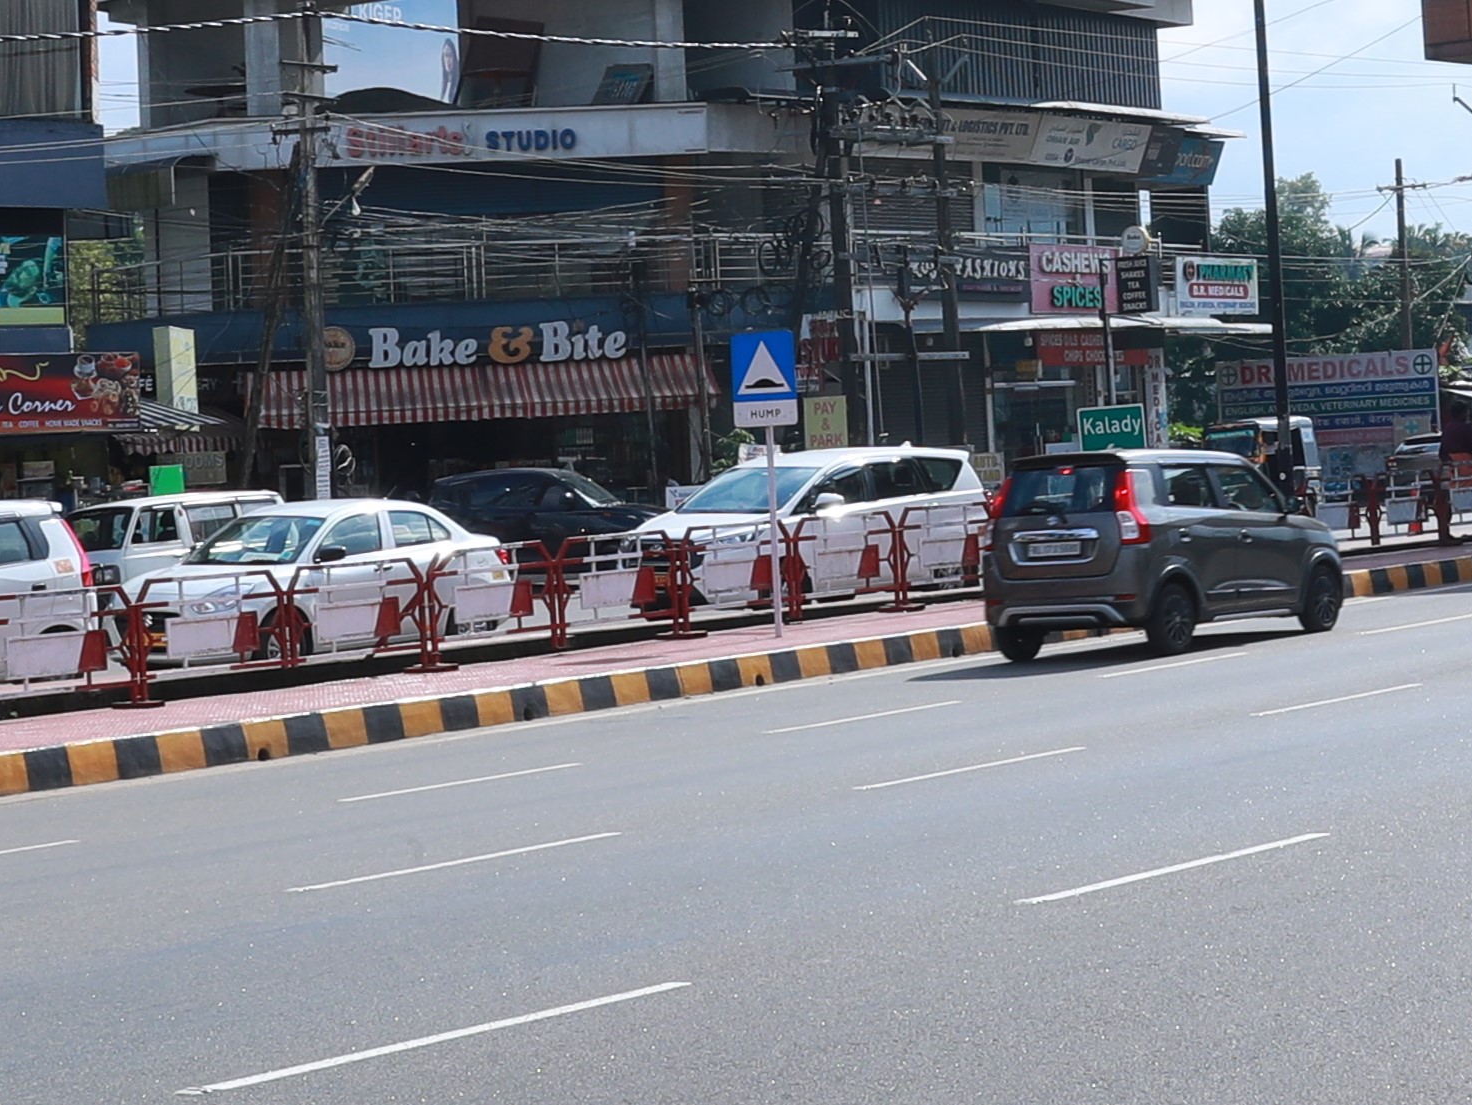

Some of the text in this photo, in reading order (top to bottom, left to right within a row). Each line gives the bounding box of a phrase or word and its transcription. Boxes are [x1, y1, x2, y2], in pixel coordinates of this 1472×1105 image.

[959, 119, 1000, 135] LOGISTICS
[485, 127, 577, 152] STUDIO
[1042, 251, 1111, 274] CASHEWS
[1121, 270, 1145, 279] SHAKES
[1127, 281, 1140, 289] TEA
[1053, 285, 1102, 308] SPICES
[1123, 291, 1146, 300] COFFEE
[369, 319, 627, 369] Bake & Bite
[1064, 350, 1083, 362] CHIPS
[1287, 355, 1410, 381] MEDICALS
[8, 392, 76, 415] Corner
[814, 401, 837, 415] PAY
[1320, 399, 1377, 412] VETERINARY
[1379, 395, 1431, 408] MEDICINES
[750, 409, 781, 419] HUMP
[821, 417, 831, 431] &
[1083, 414, 1141, 436] Kalady
[810, 433, 843, 447] PARK
